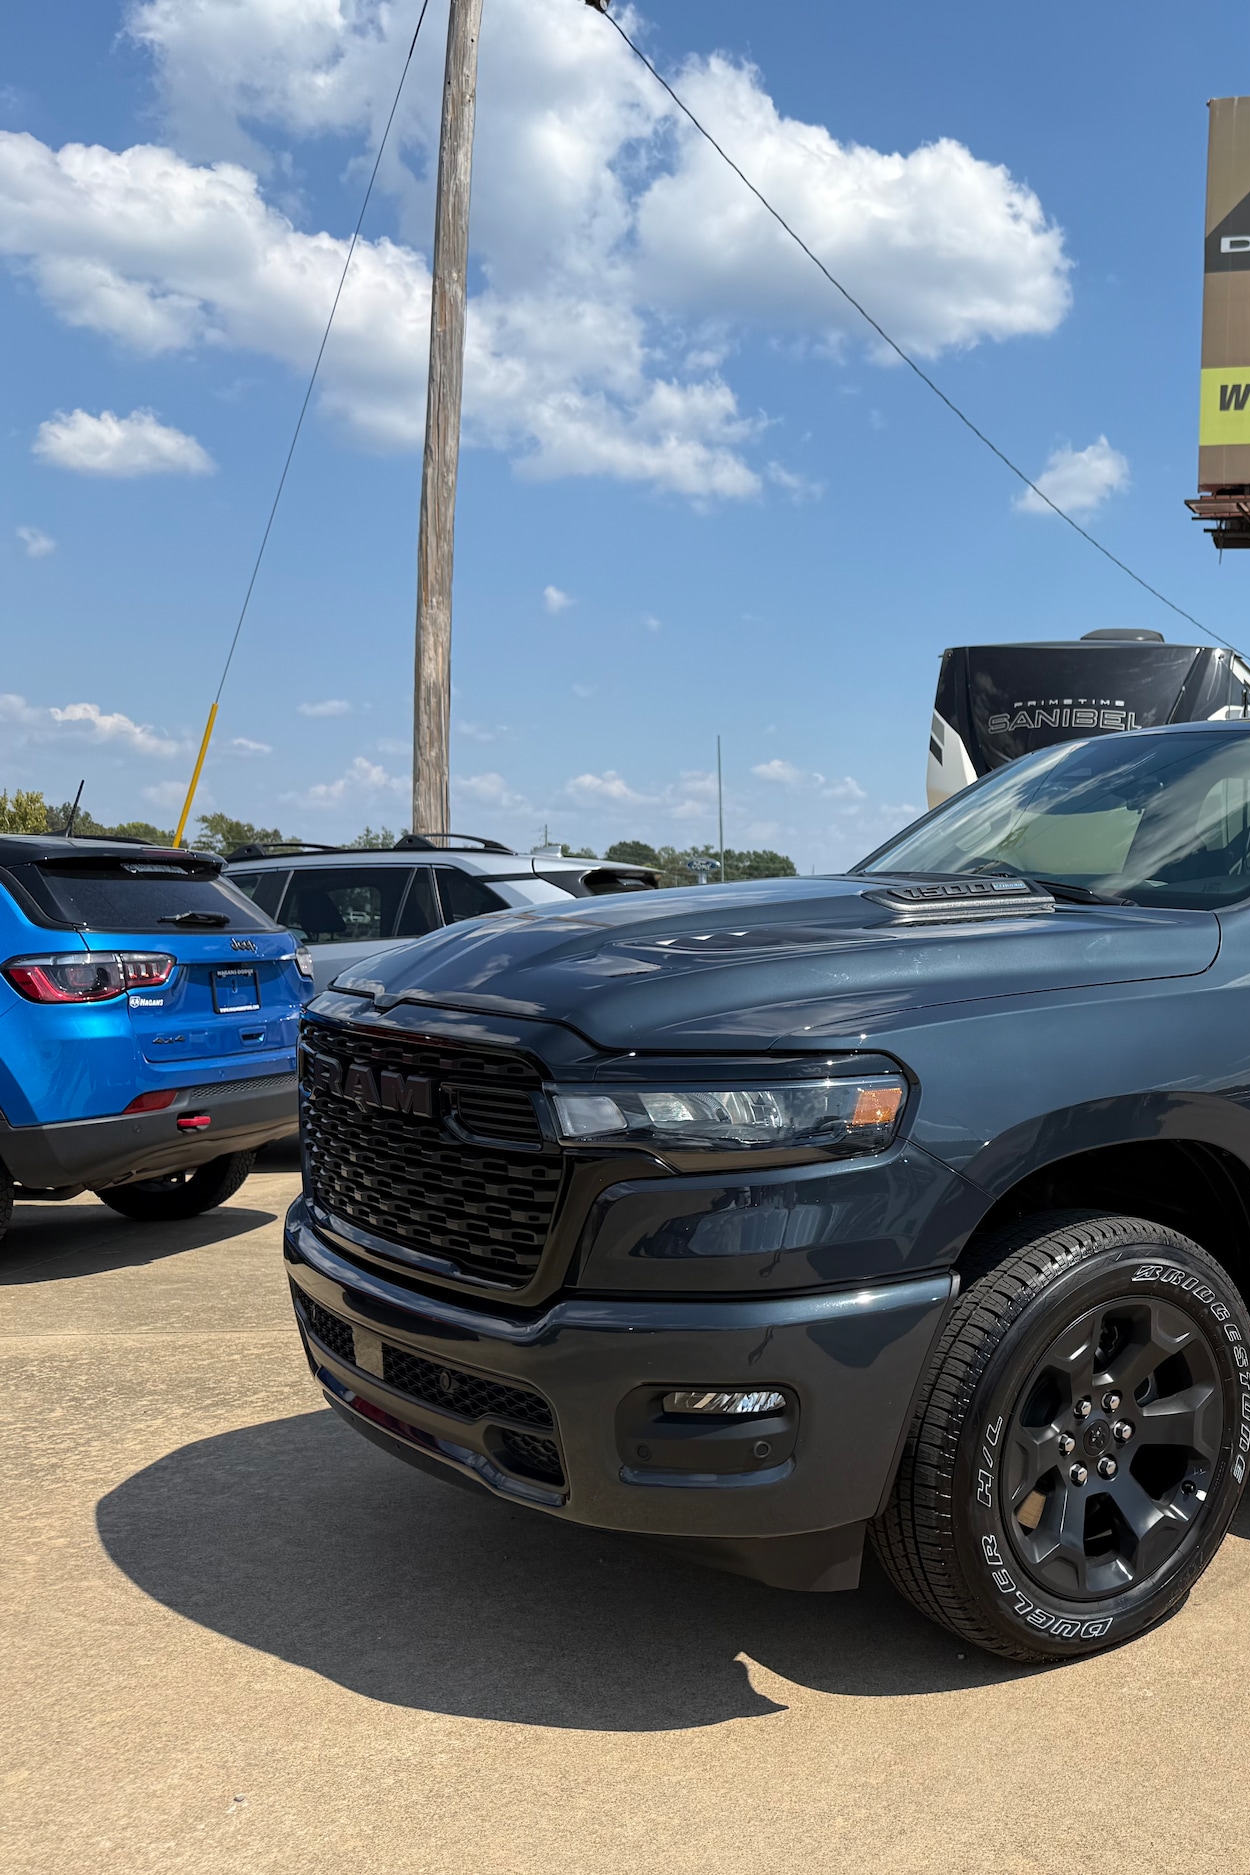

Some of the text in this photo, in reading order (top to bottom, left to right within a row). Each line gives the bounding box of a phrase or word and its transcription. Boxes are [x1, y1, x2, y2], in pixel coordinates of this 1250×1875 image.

[988, 708, 1143, 734] SANIBEL
[904, 882, 991, 899] 1500
[140, 998, 164, 1007] HAGANS
[313, 1052, 435, 1119] RAM
[981, 1534, 1114, 1639] DUELER
